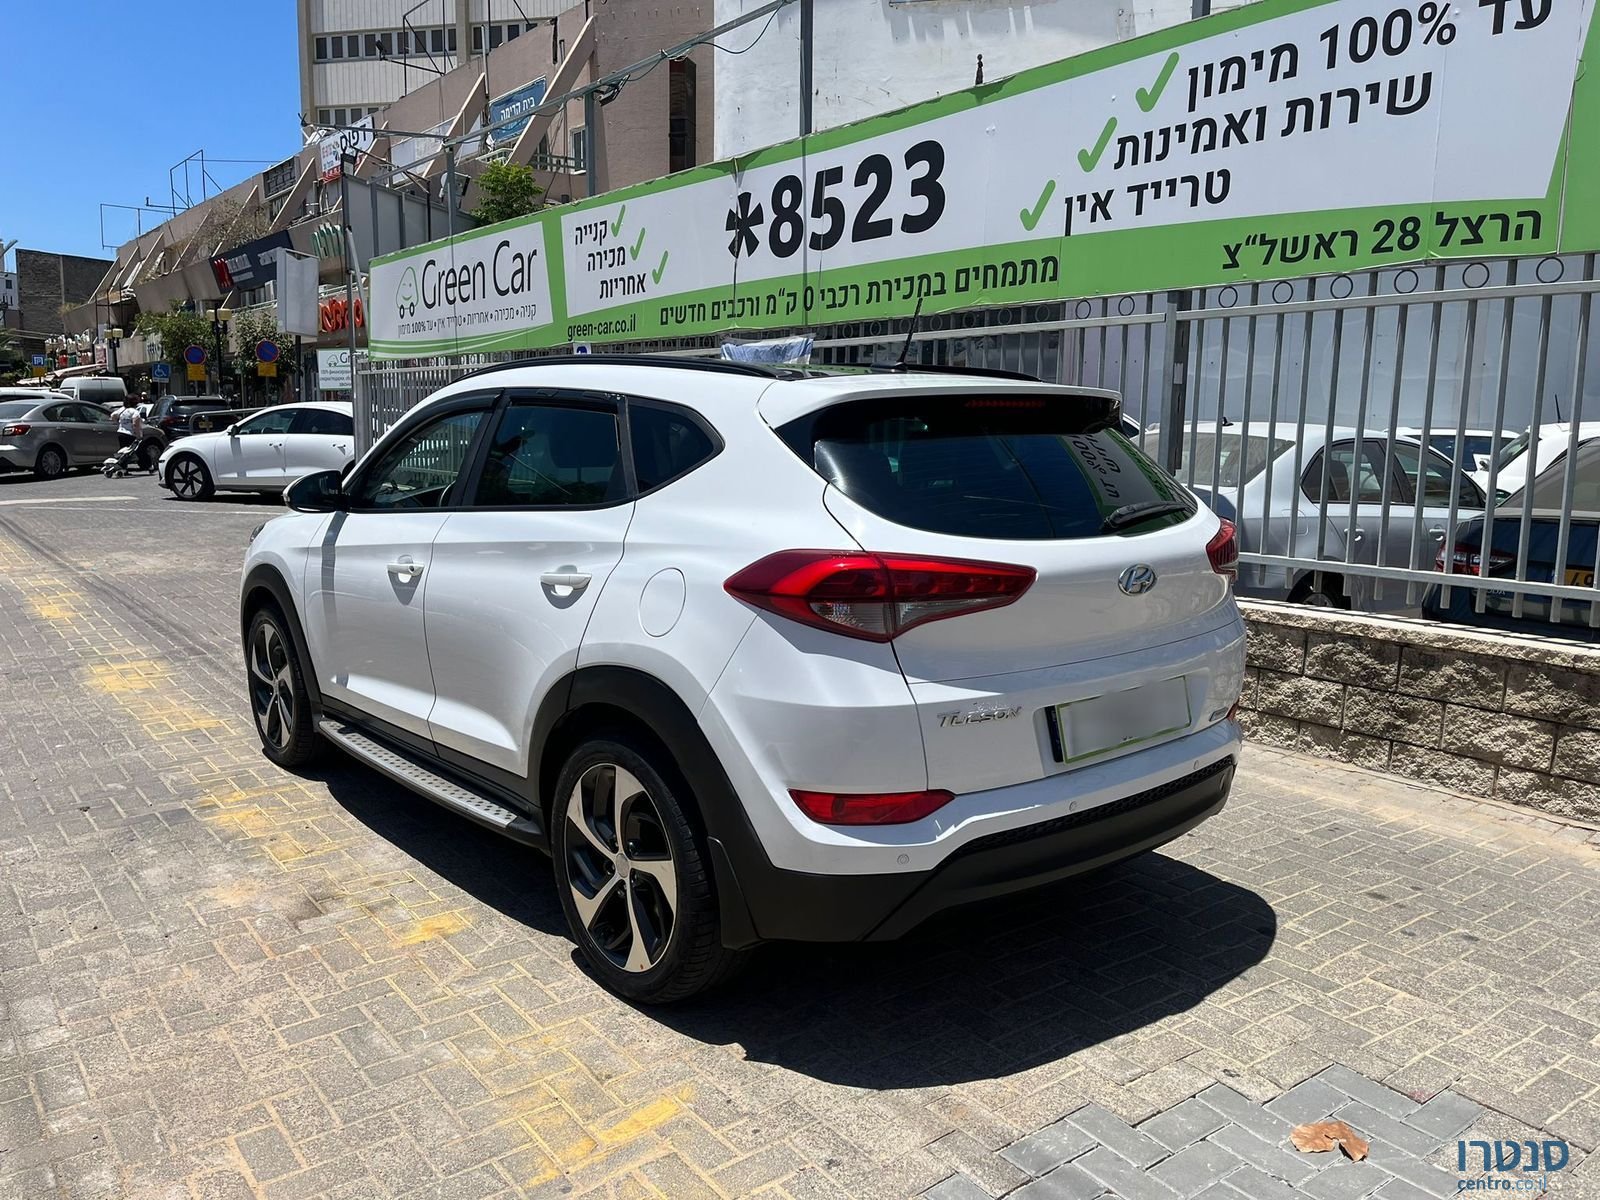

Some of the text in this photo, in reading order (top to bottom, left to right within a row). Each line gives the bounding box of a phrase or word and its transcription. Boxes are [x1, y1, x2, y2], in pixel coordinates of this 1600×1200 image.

[1186, 0, 1552, 112] עד 100% מימון
[522, 97, 535, 111] בית
[1113, 71, 1433, 170] שירות ואמינות
[1064, 168, 1231, 237] טרייד אין
[574, 219, 608, 246] קנייה
[1222, 210, 1542, 269] הרצל 28 ראשל"צ
[587, 246, 626, 272] מכירה
[955, 254, 1058, 291] מתמחים
[421, 240, 537, 309] Green Car
[599, 272, 647, 299] אחריות
[866, 270, 947, 305] במכירת
[711, 296, 760, 320] ורכבים
[803, 286, 814, 312] 0
[819, 283, 860, 312] רכבי
[493, 307, 515, 322] מכירה
[519, 303, 537, 321] קניה
[660, 302, 706, 326] חדשים
[567, 313, 636, 341] green-car.co.il
[936, 705, 1022, 728] TUCSON
